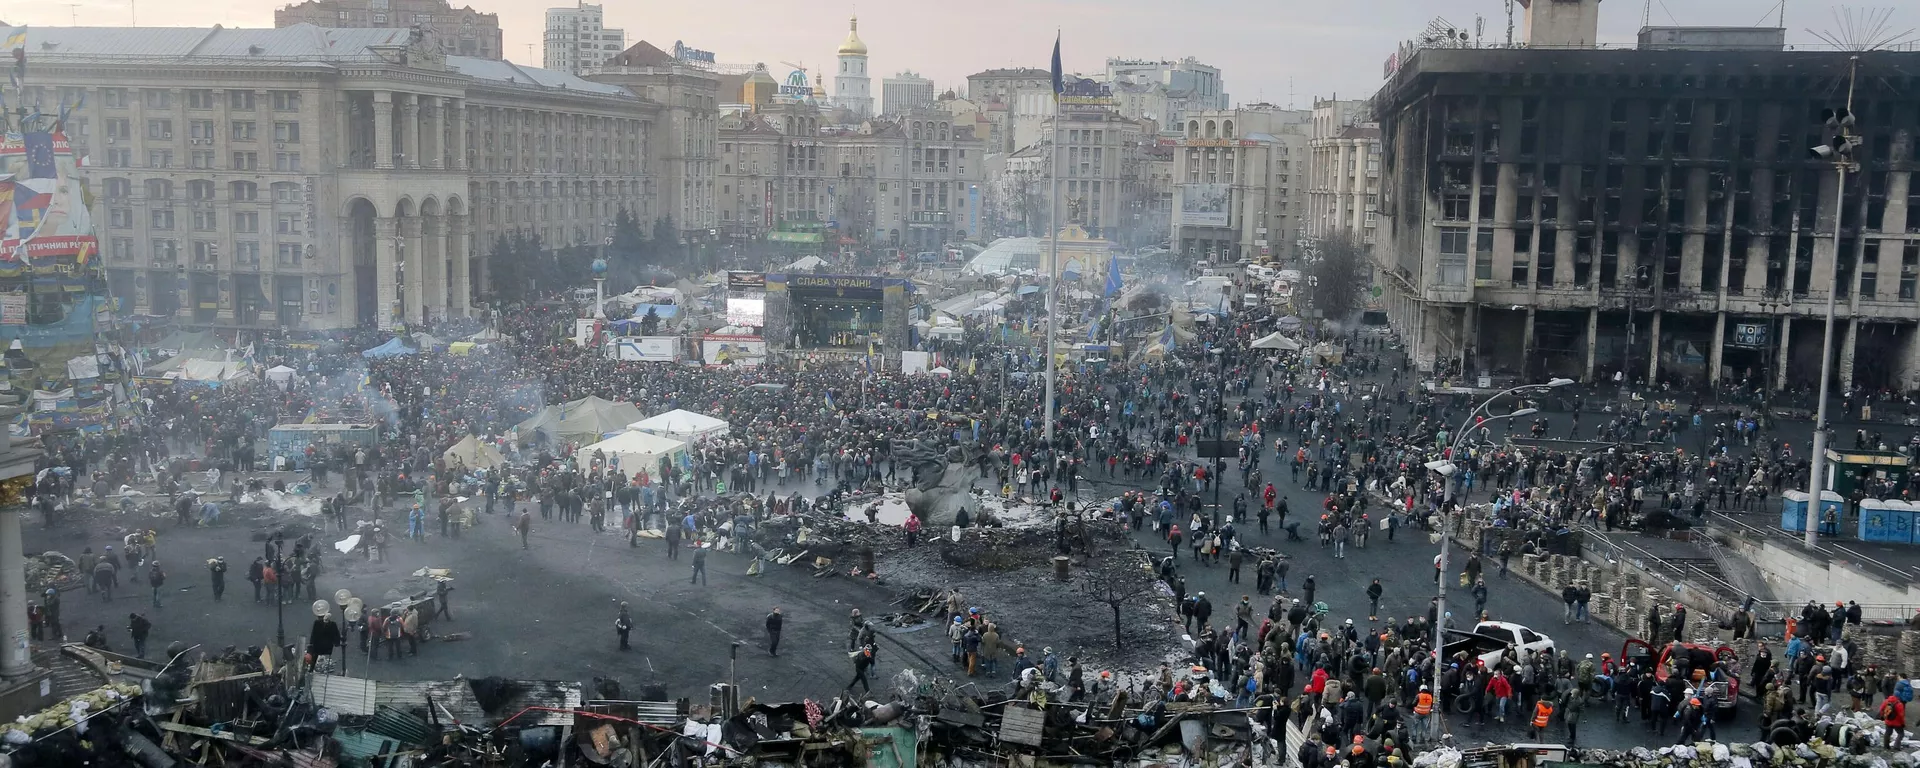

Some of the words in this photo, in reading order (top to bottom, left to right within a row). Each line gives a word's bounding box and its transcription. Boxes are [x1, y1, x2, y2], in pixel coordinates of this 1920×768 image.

[780, 85, 813, 96] МЕТРОБУД
[797, 277, 830, 286] СЛАВА
[833, 278, 871, 288] УКРАЇНІ!
